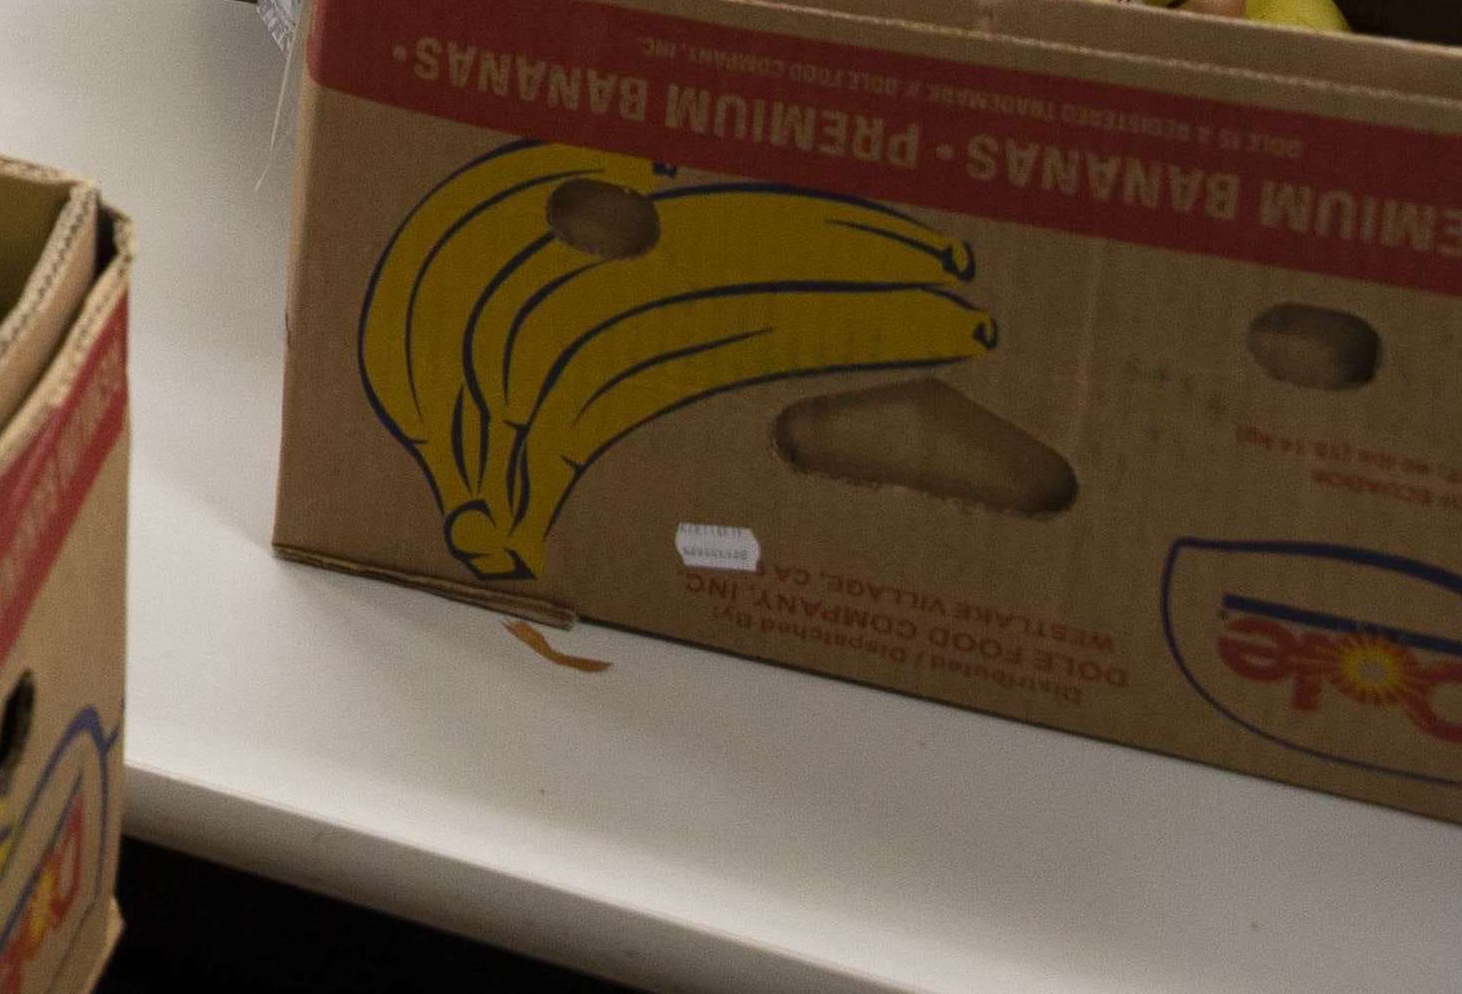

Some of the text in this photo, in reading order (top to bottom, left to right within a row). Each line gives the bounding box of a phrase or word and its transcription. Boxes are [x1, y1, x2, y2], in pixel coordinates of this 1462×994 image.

[411, 34, 921, 170] PREMIUM BANANAS
[964, 132, 1462, 257] EMIUM BANANAS
[676, 569, 1129, 689] DOLE FOOD COMPANY, INC.
[759, 618, 908, 666] Dispatched
[774, 566, 1116, 655] WESTLAKE VILLAGE, CA
[927, 652, 1082, 705] Distributed
